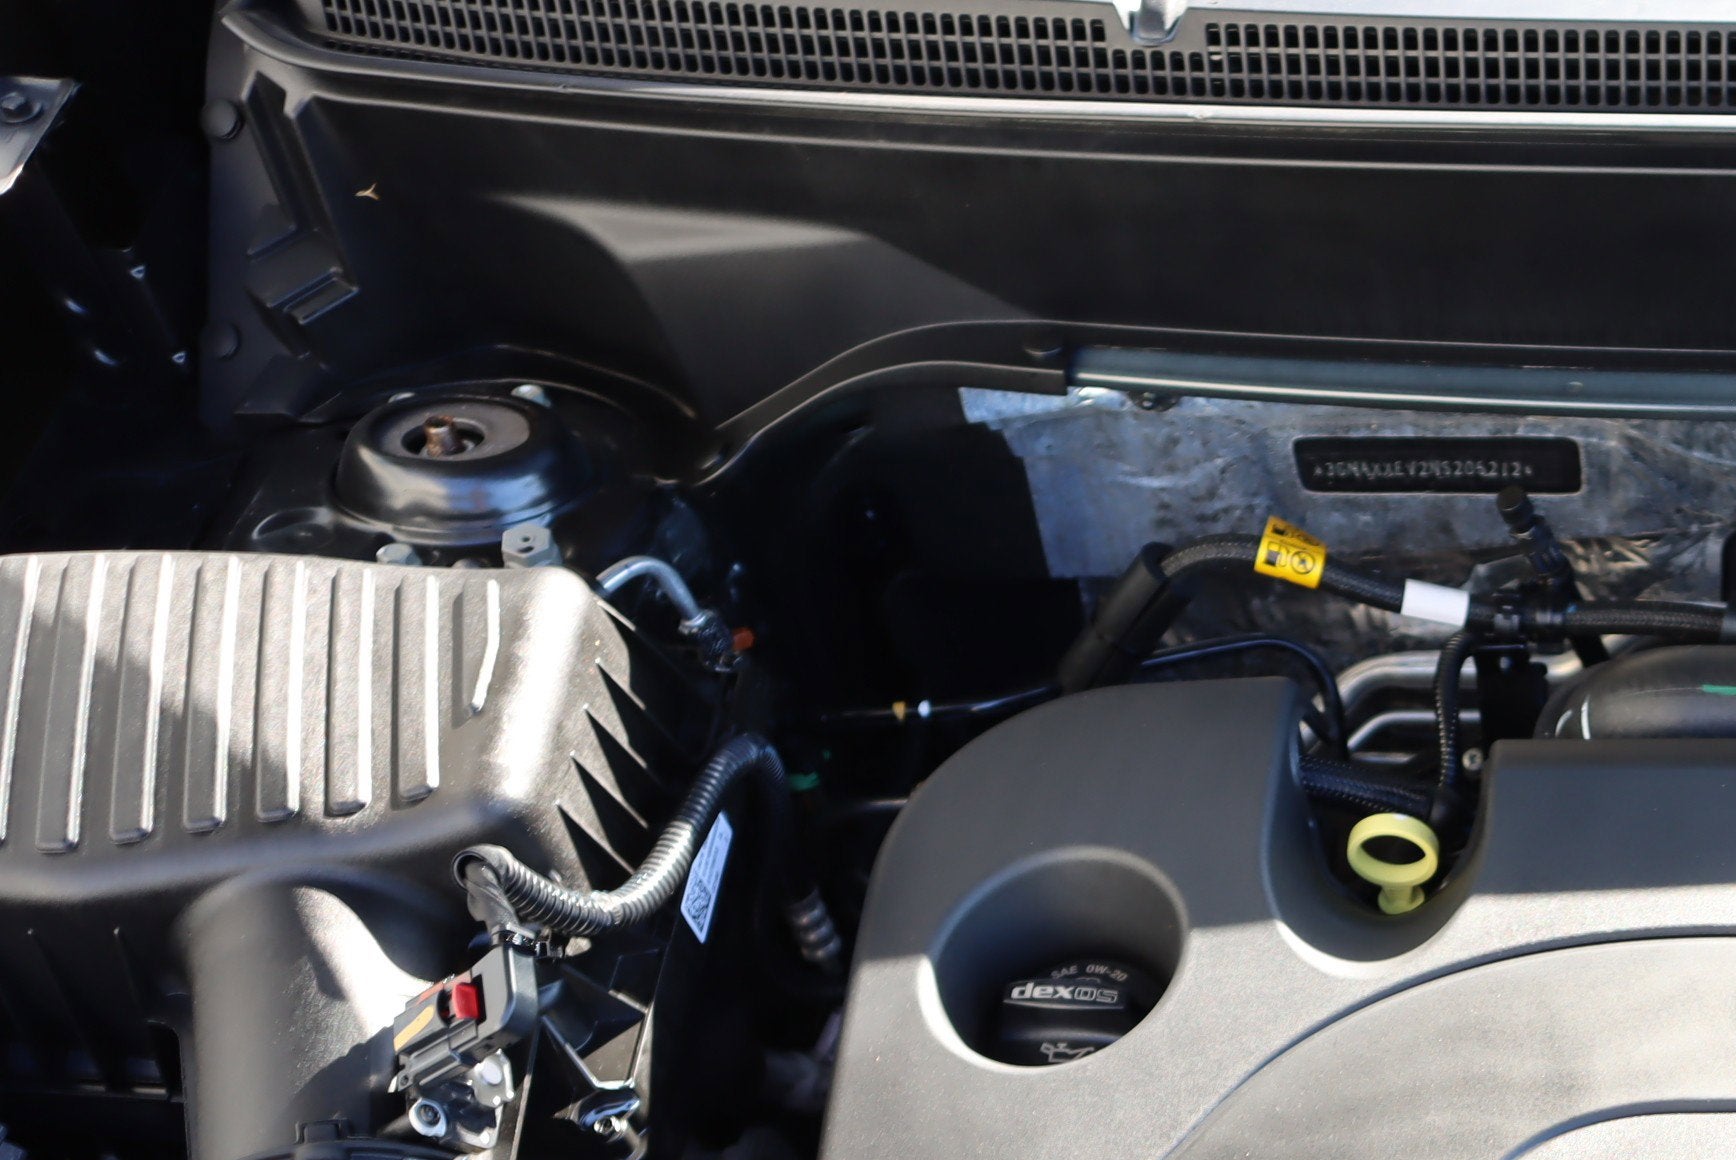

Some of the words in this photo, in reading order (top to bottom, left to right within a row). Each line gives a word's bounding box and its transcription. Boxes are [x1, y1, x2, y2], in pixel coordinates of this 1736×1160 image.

[1051, 965, 1078, 979] SAE
[1085, 964, 1128, 982] 0W-20
[1010, 982, 1119, 1003] dexos
